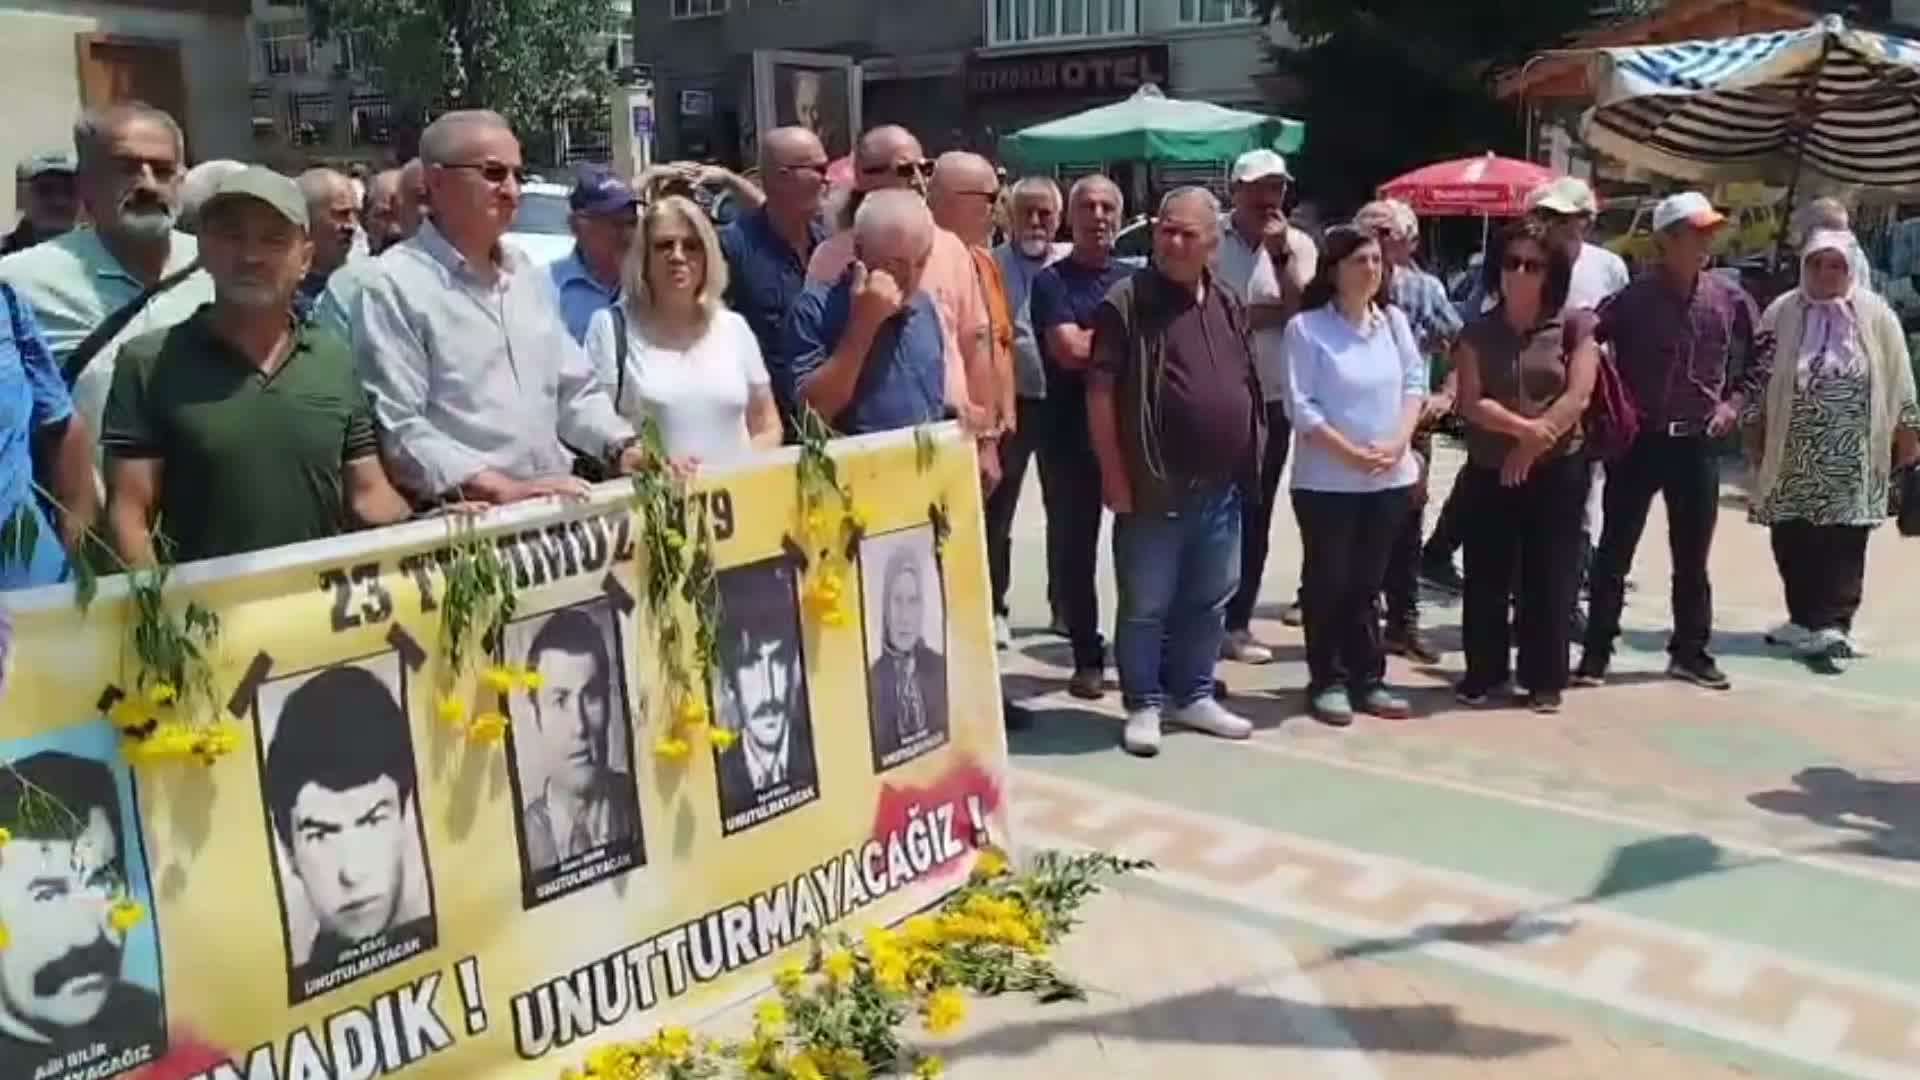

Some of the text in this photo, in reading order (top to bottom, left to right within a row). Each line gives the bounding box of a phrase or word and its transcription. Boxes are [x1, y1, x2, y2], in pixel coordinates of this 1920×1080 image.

[1061, 55, 1164, 88] OTEL
[319, 563, 393, 632] 23
[401, 511, 635, 613] TMMUZ
[512, 804, 964, 1058] UNUTTURMAYACAĞIZ
[186, 970, 455, 1080] MADIK
